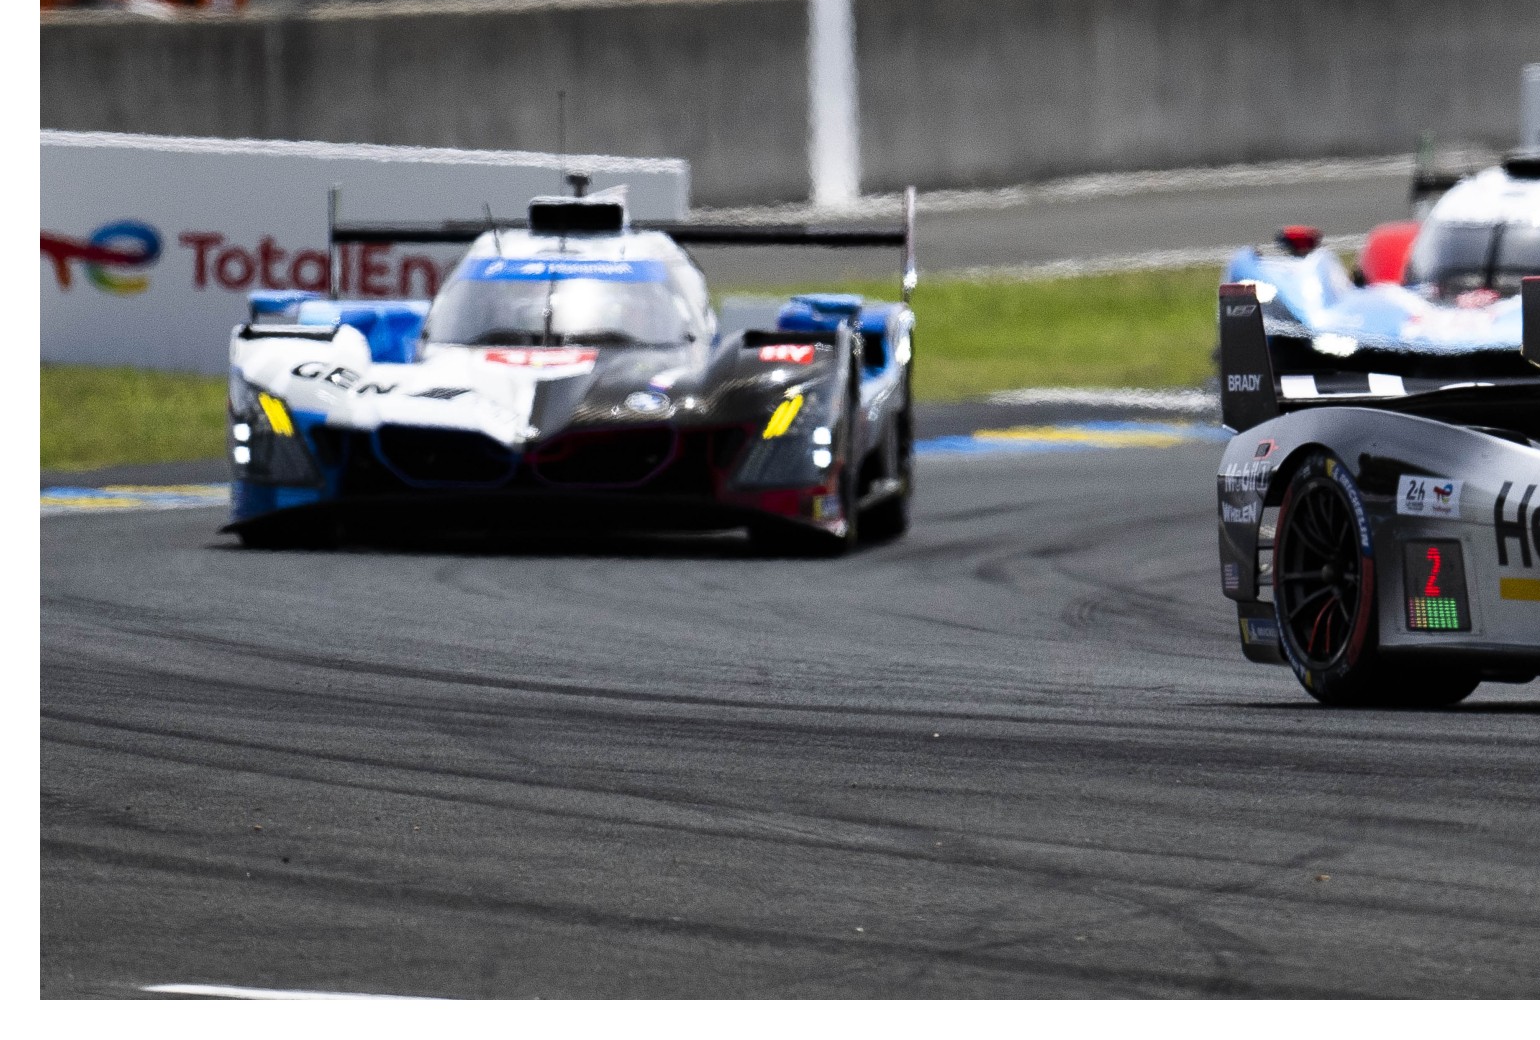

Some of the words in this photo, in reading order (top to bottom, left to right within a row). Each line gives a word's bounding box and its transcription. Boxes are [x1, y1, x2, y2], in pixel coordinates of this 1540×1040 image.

[1227, 374, 1262, 392] BRADY
[1222, 501, 1257, 523] WHELEN
[1424, 547, 1442, 597] 2
